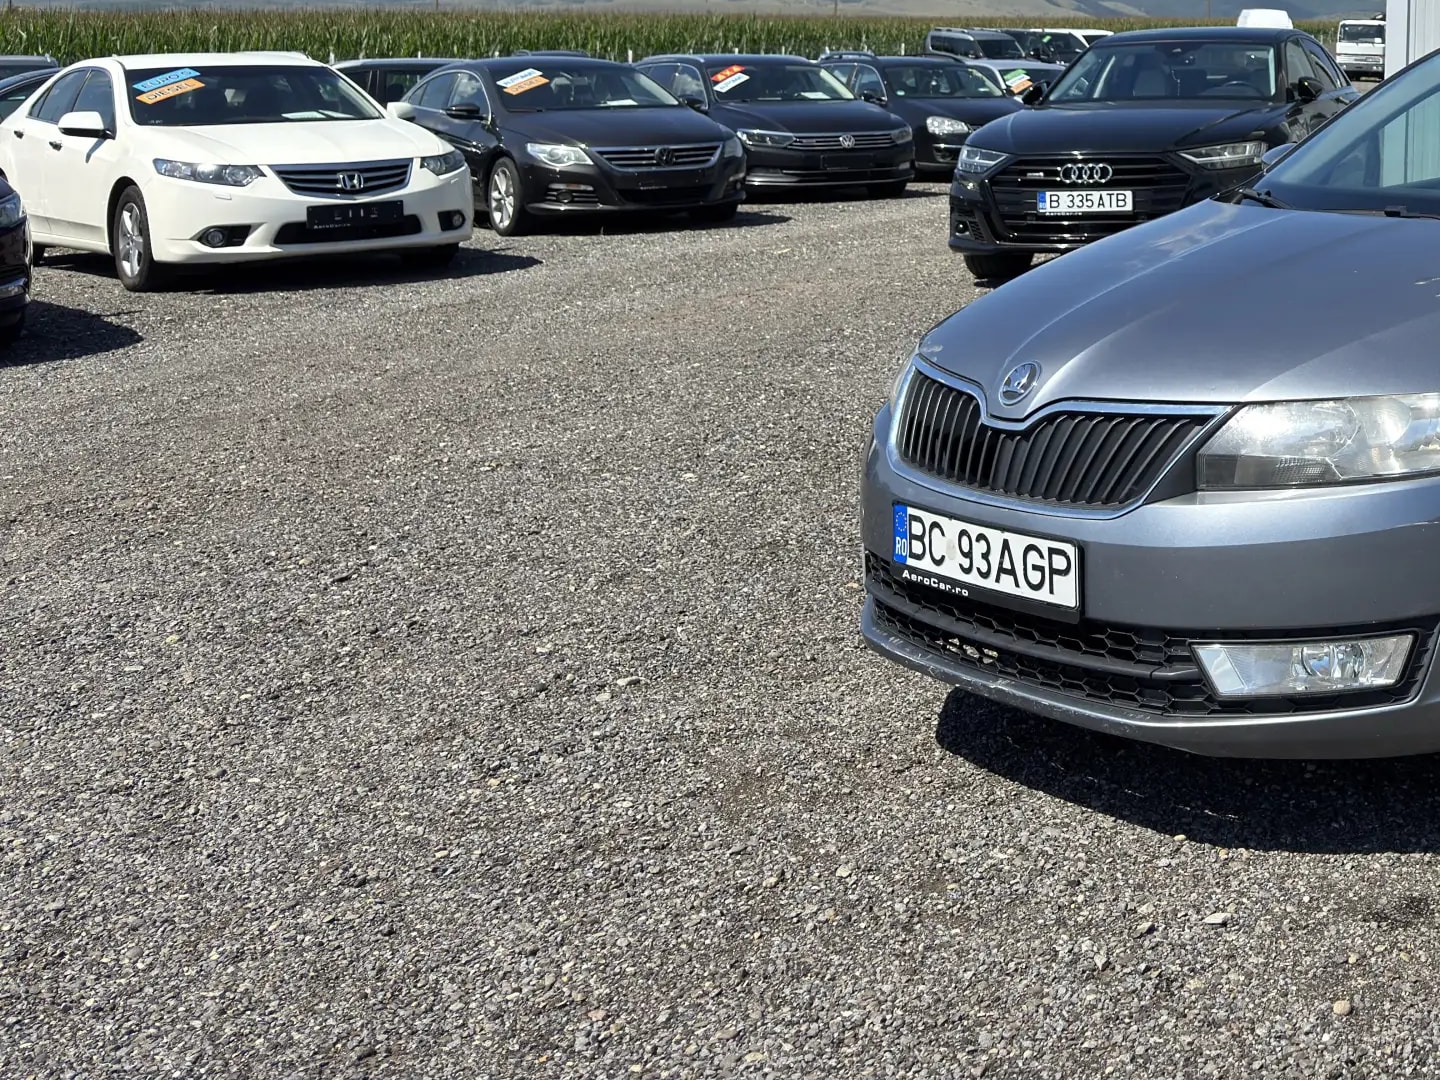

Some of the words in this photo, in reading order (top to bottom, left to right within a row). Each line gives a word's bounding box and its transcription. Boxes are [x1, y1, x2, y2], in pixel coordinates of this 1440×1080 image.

[895, 536, 908, 557] RO
[908, 513, 946, 567] BC
[902, 569, 969, 597] AeroCar.ro
